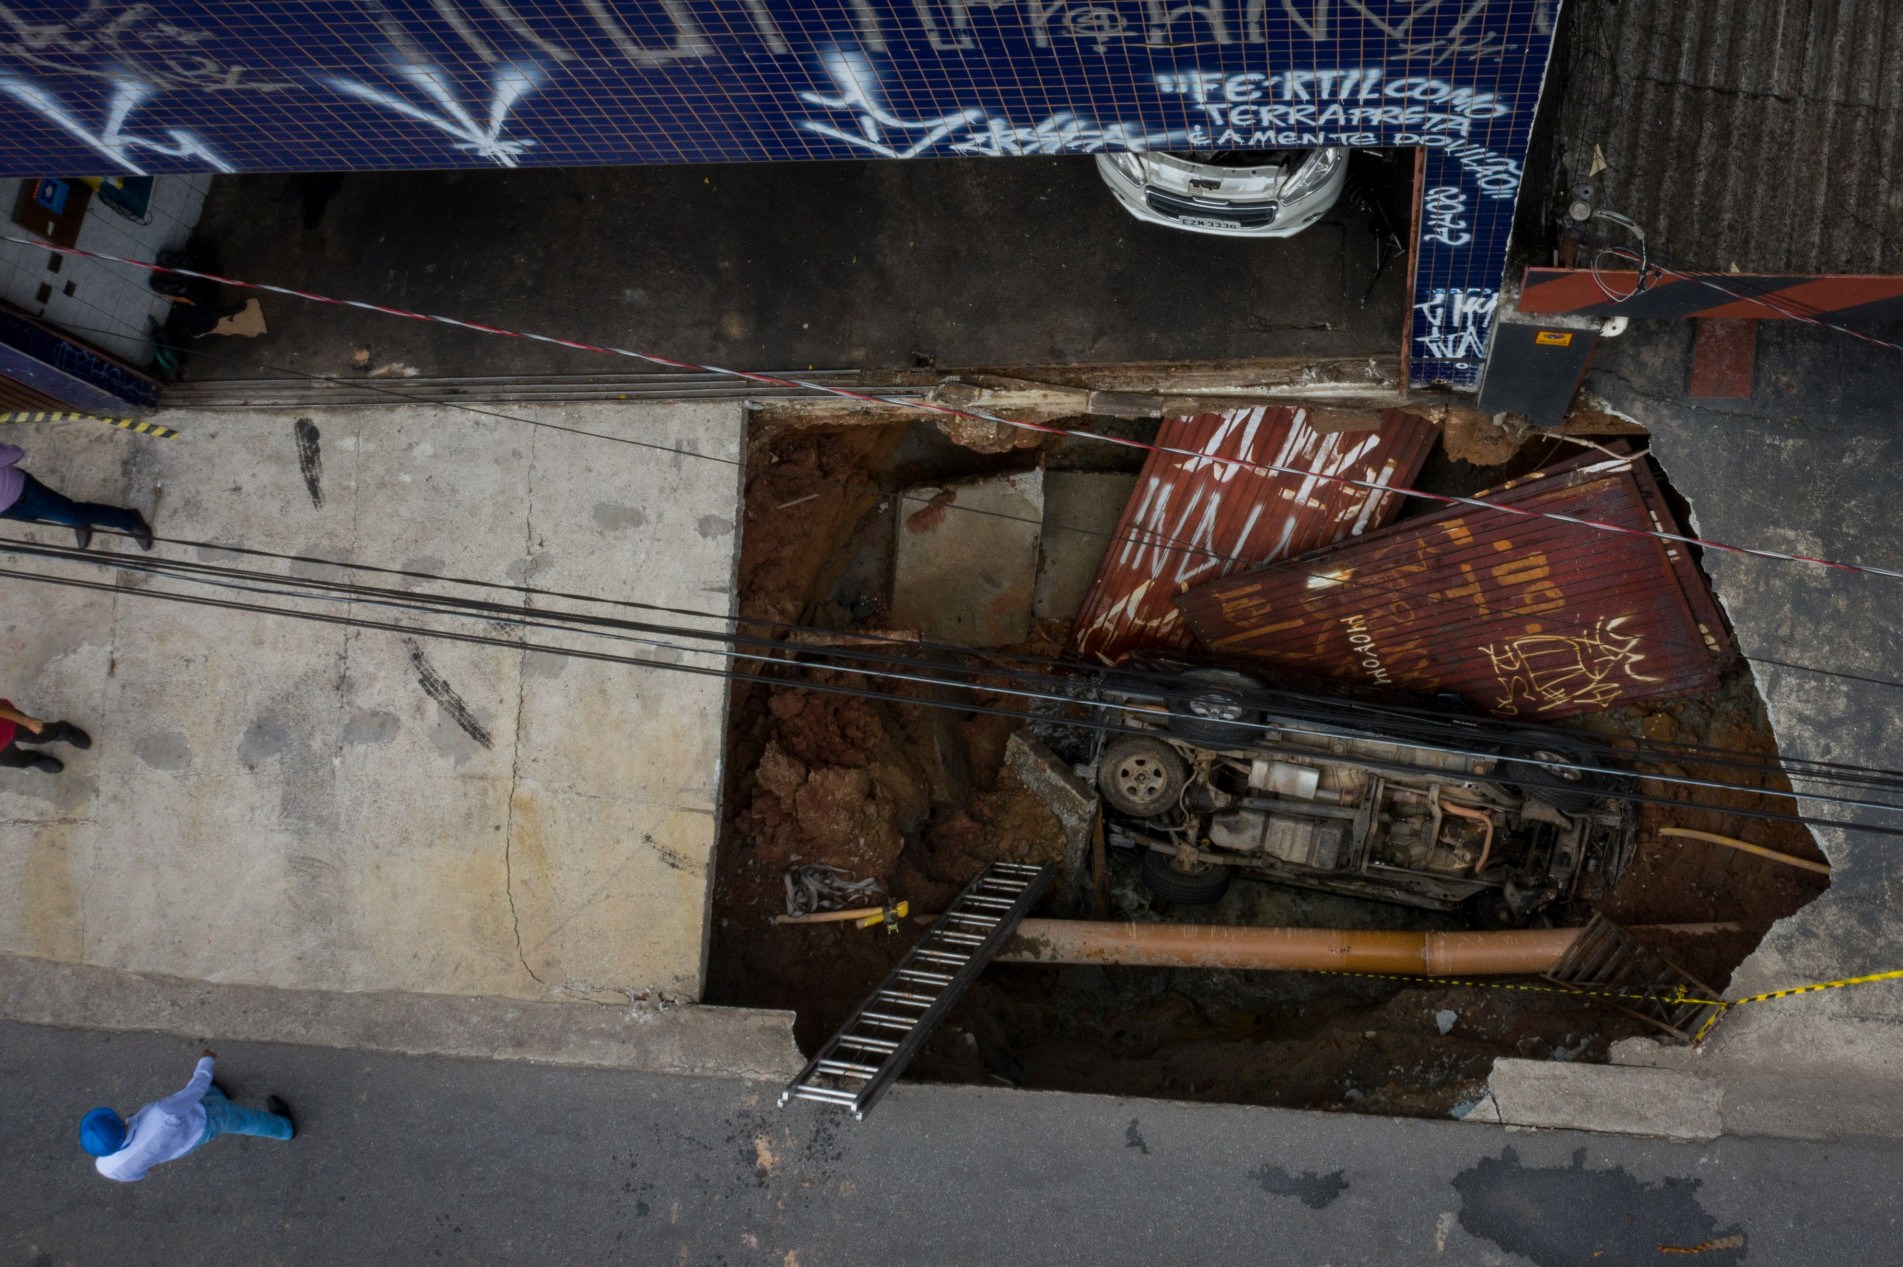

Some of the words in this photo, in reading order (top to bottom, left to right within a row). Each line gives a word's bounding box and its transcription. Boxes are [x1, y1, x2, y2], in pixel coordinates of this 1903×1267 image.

[1195, 103, 1346, 127] TERRA
[1348, 106, 1471, 137] PRETA
[1248, 129, 1379, 149] MENTE
